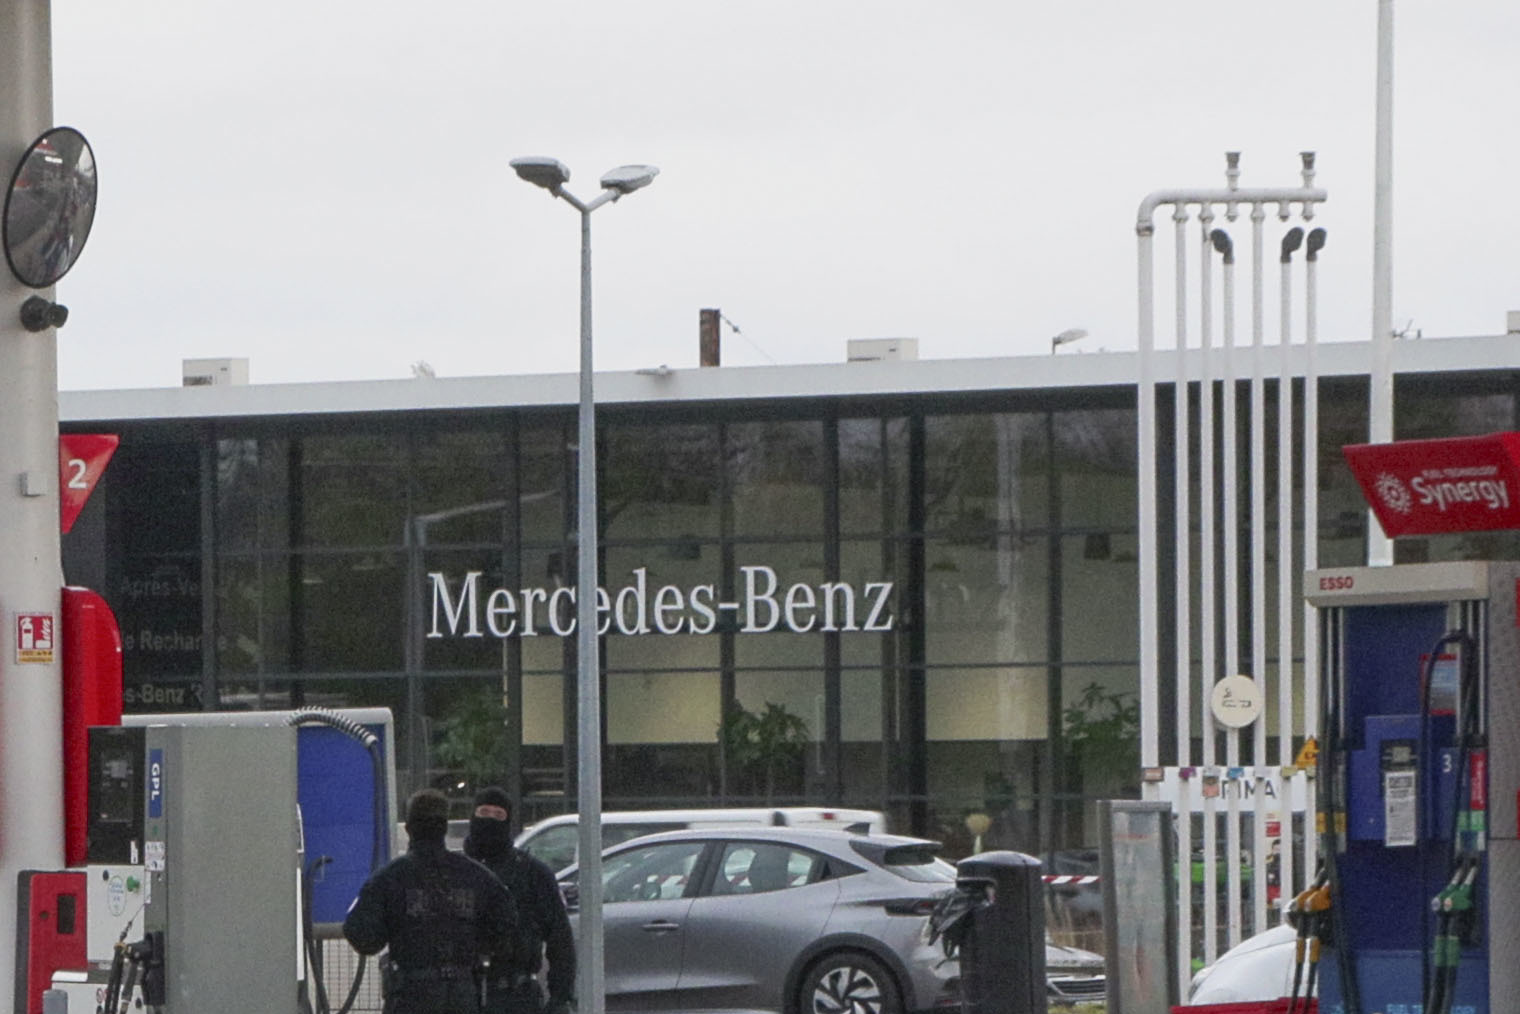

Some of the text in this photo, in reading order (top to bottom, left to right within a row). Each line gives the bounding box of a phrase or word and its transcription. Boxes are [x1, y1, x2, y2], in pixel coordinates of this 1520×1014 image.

[67, 460, 87, 488] 2
[1412, 477, 1509, 511] Synergy
[1320, 576, 1353, 590] ESSO
[427, 565, 895, 638] Mercedes-Benz
[1442, 754, 1452, 773] 3
[151, 763, 160, 801] GPL
